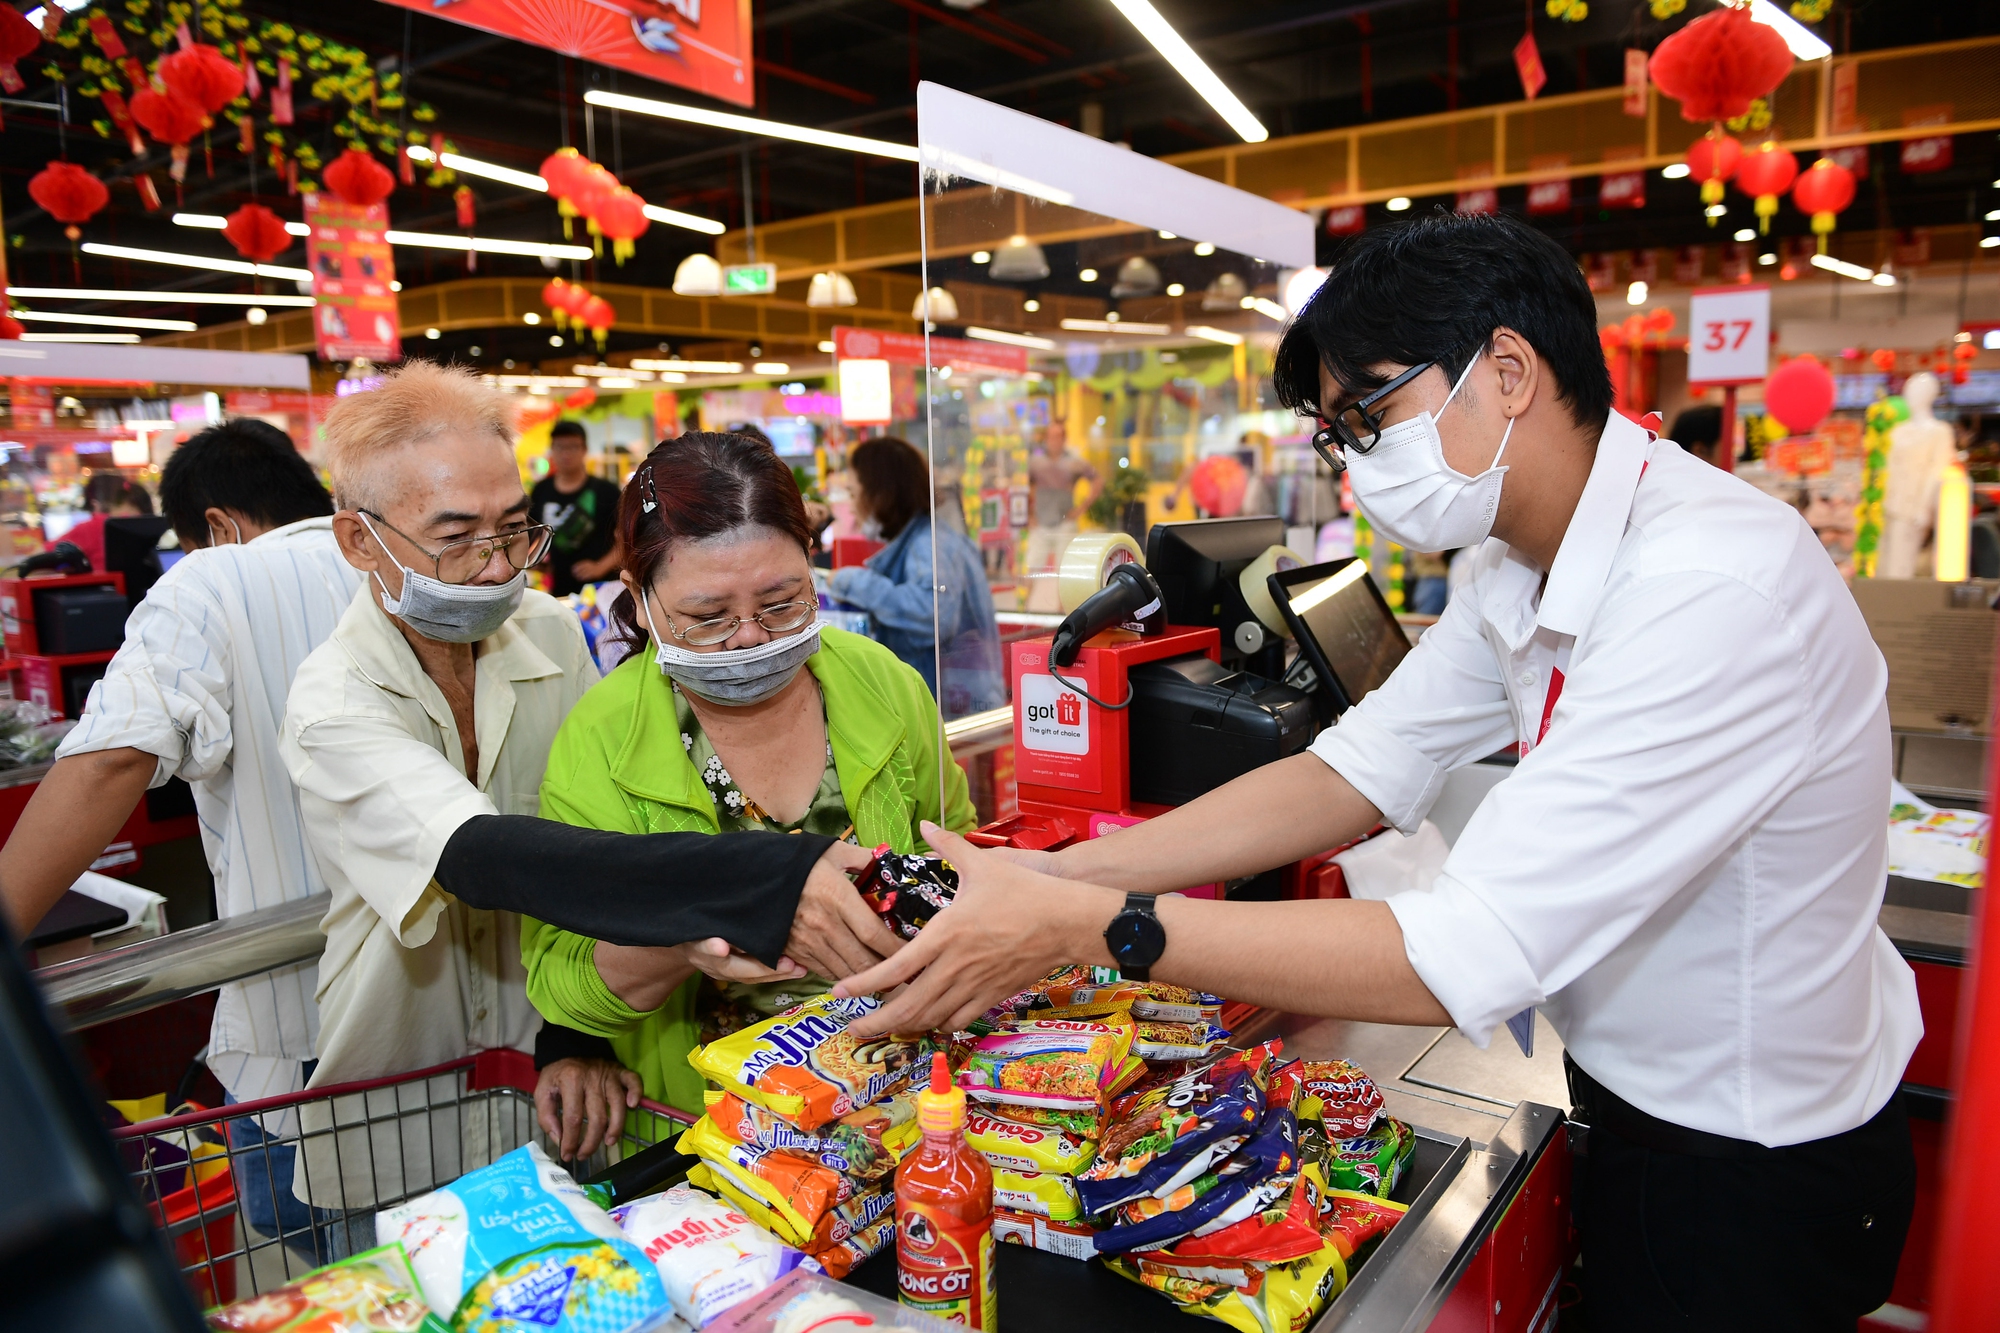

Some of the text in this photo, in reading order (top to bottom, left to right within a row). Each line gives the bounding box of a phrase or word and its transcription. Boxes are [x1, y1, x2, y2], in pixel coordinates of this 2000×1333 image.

[1703, 320, 1752, 352] 37
[1028, 704, 1074, 721] got it
[1029, 726, 1040, 734] The
[1041, 728, 1051, 736] gift
[1060, 730, 1081, 738] choice
[757, 1015, 838, 1067] Jin
[864, 1073, 888, 1104] Jin
[770, 1122, 794, 1149] Jin
[989, 1122, 1045, 1144] Gấu
[479, 1202, 558, 1230] Luyện
[511, 1211, 569, 1235] Tinh
[862, 1194, 883, 1228] Jin
[644, 1216, 714, 1264] MUỐI
[941, 1272, 970, 1293] ỚT
